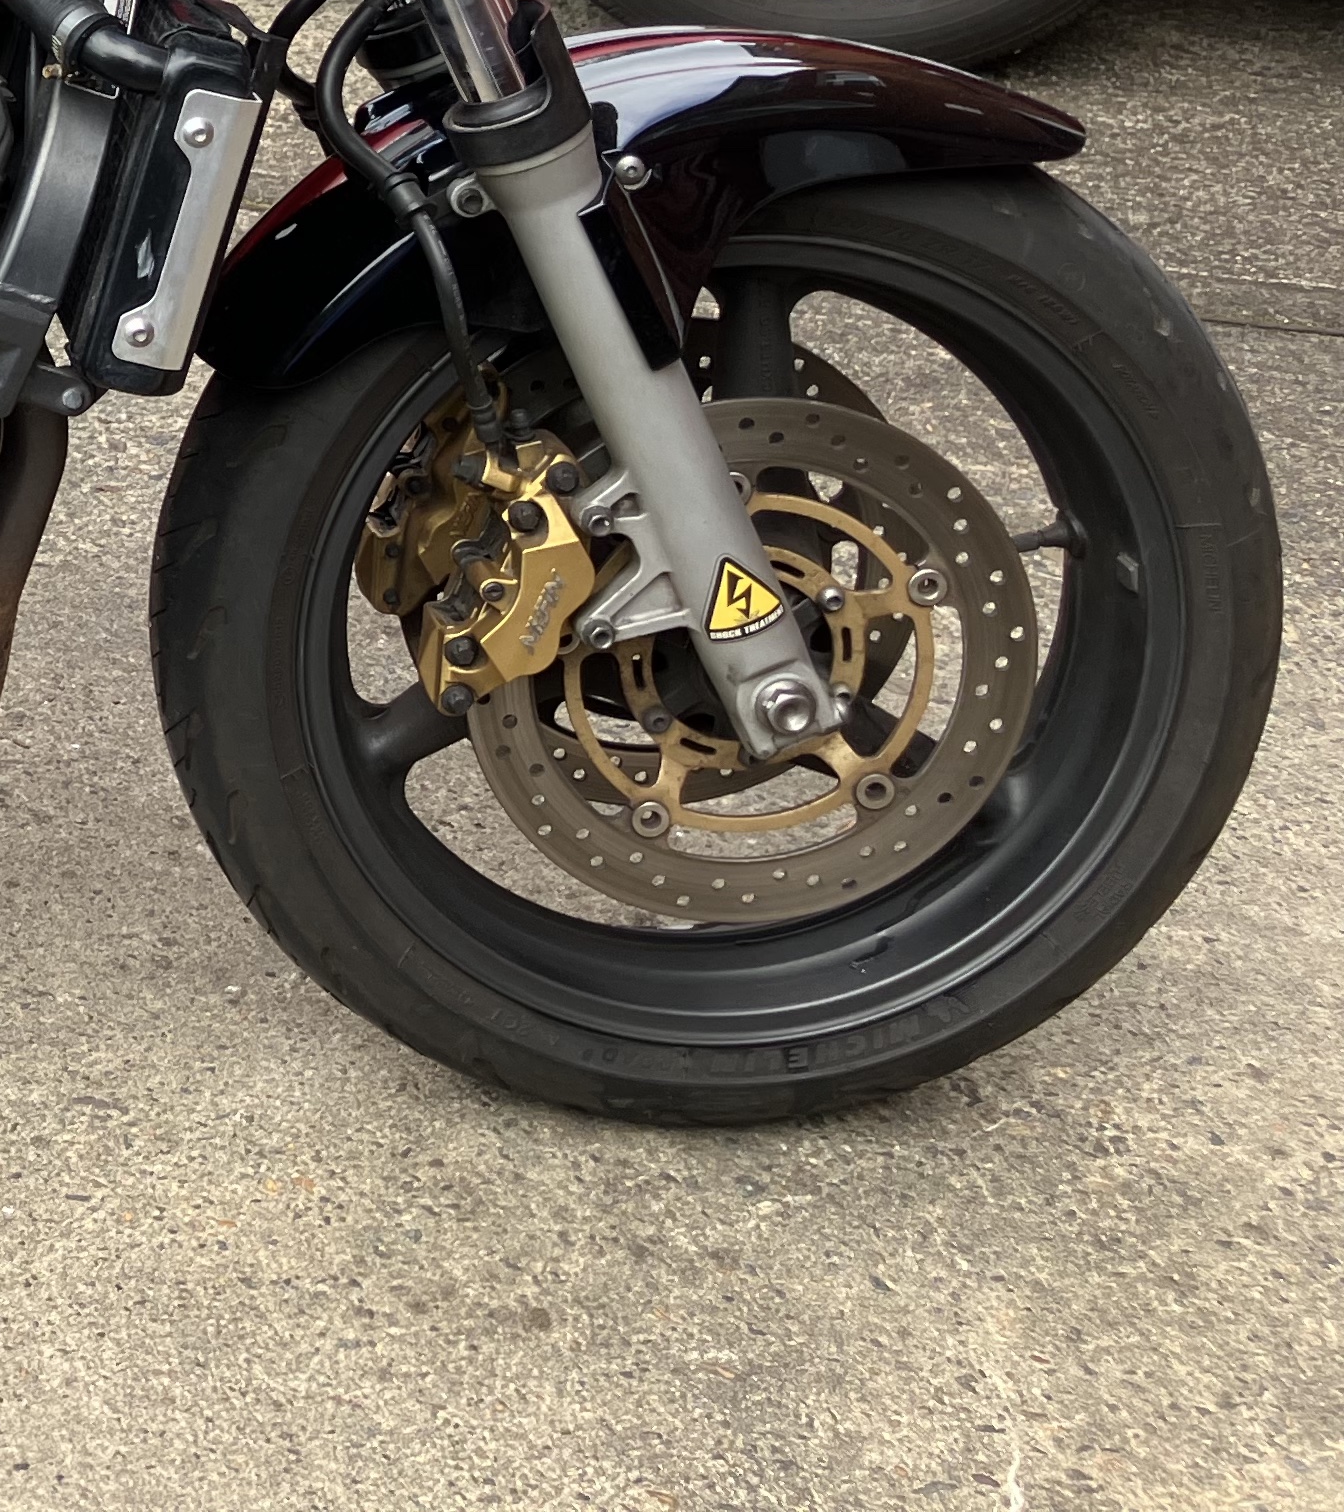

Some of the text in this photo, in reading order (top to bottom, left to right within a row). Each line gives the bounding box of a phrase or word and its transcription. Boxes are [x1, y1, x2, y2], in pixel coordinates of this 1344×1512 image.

[1194, 531, 1226, 613] MICHELIN
[518, 567, 566, 656] NISSIN
[709, 628, 743, 640] SHOCK
[709, 1014, 926, 1072] MICHELIN
